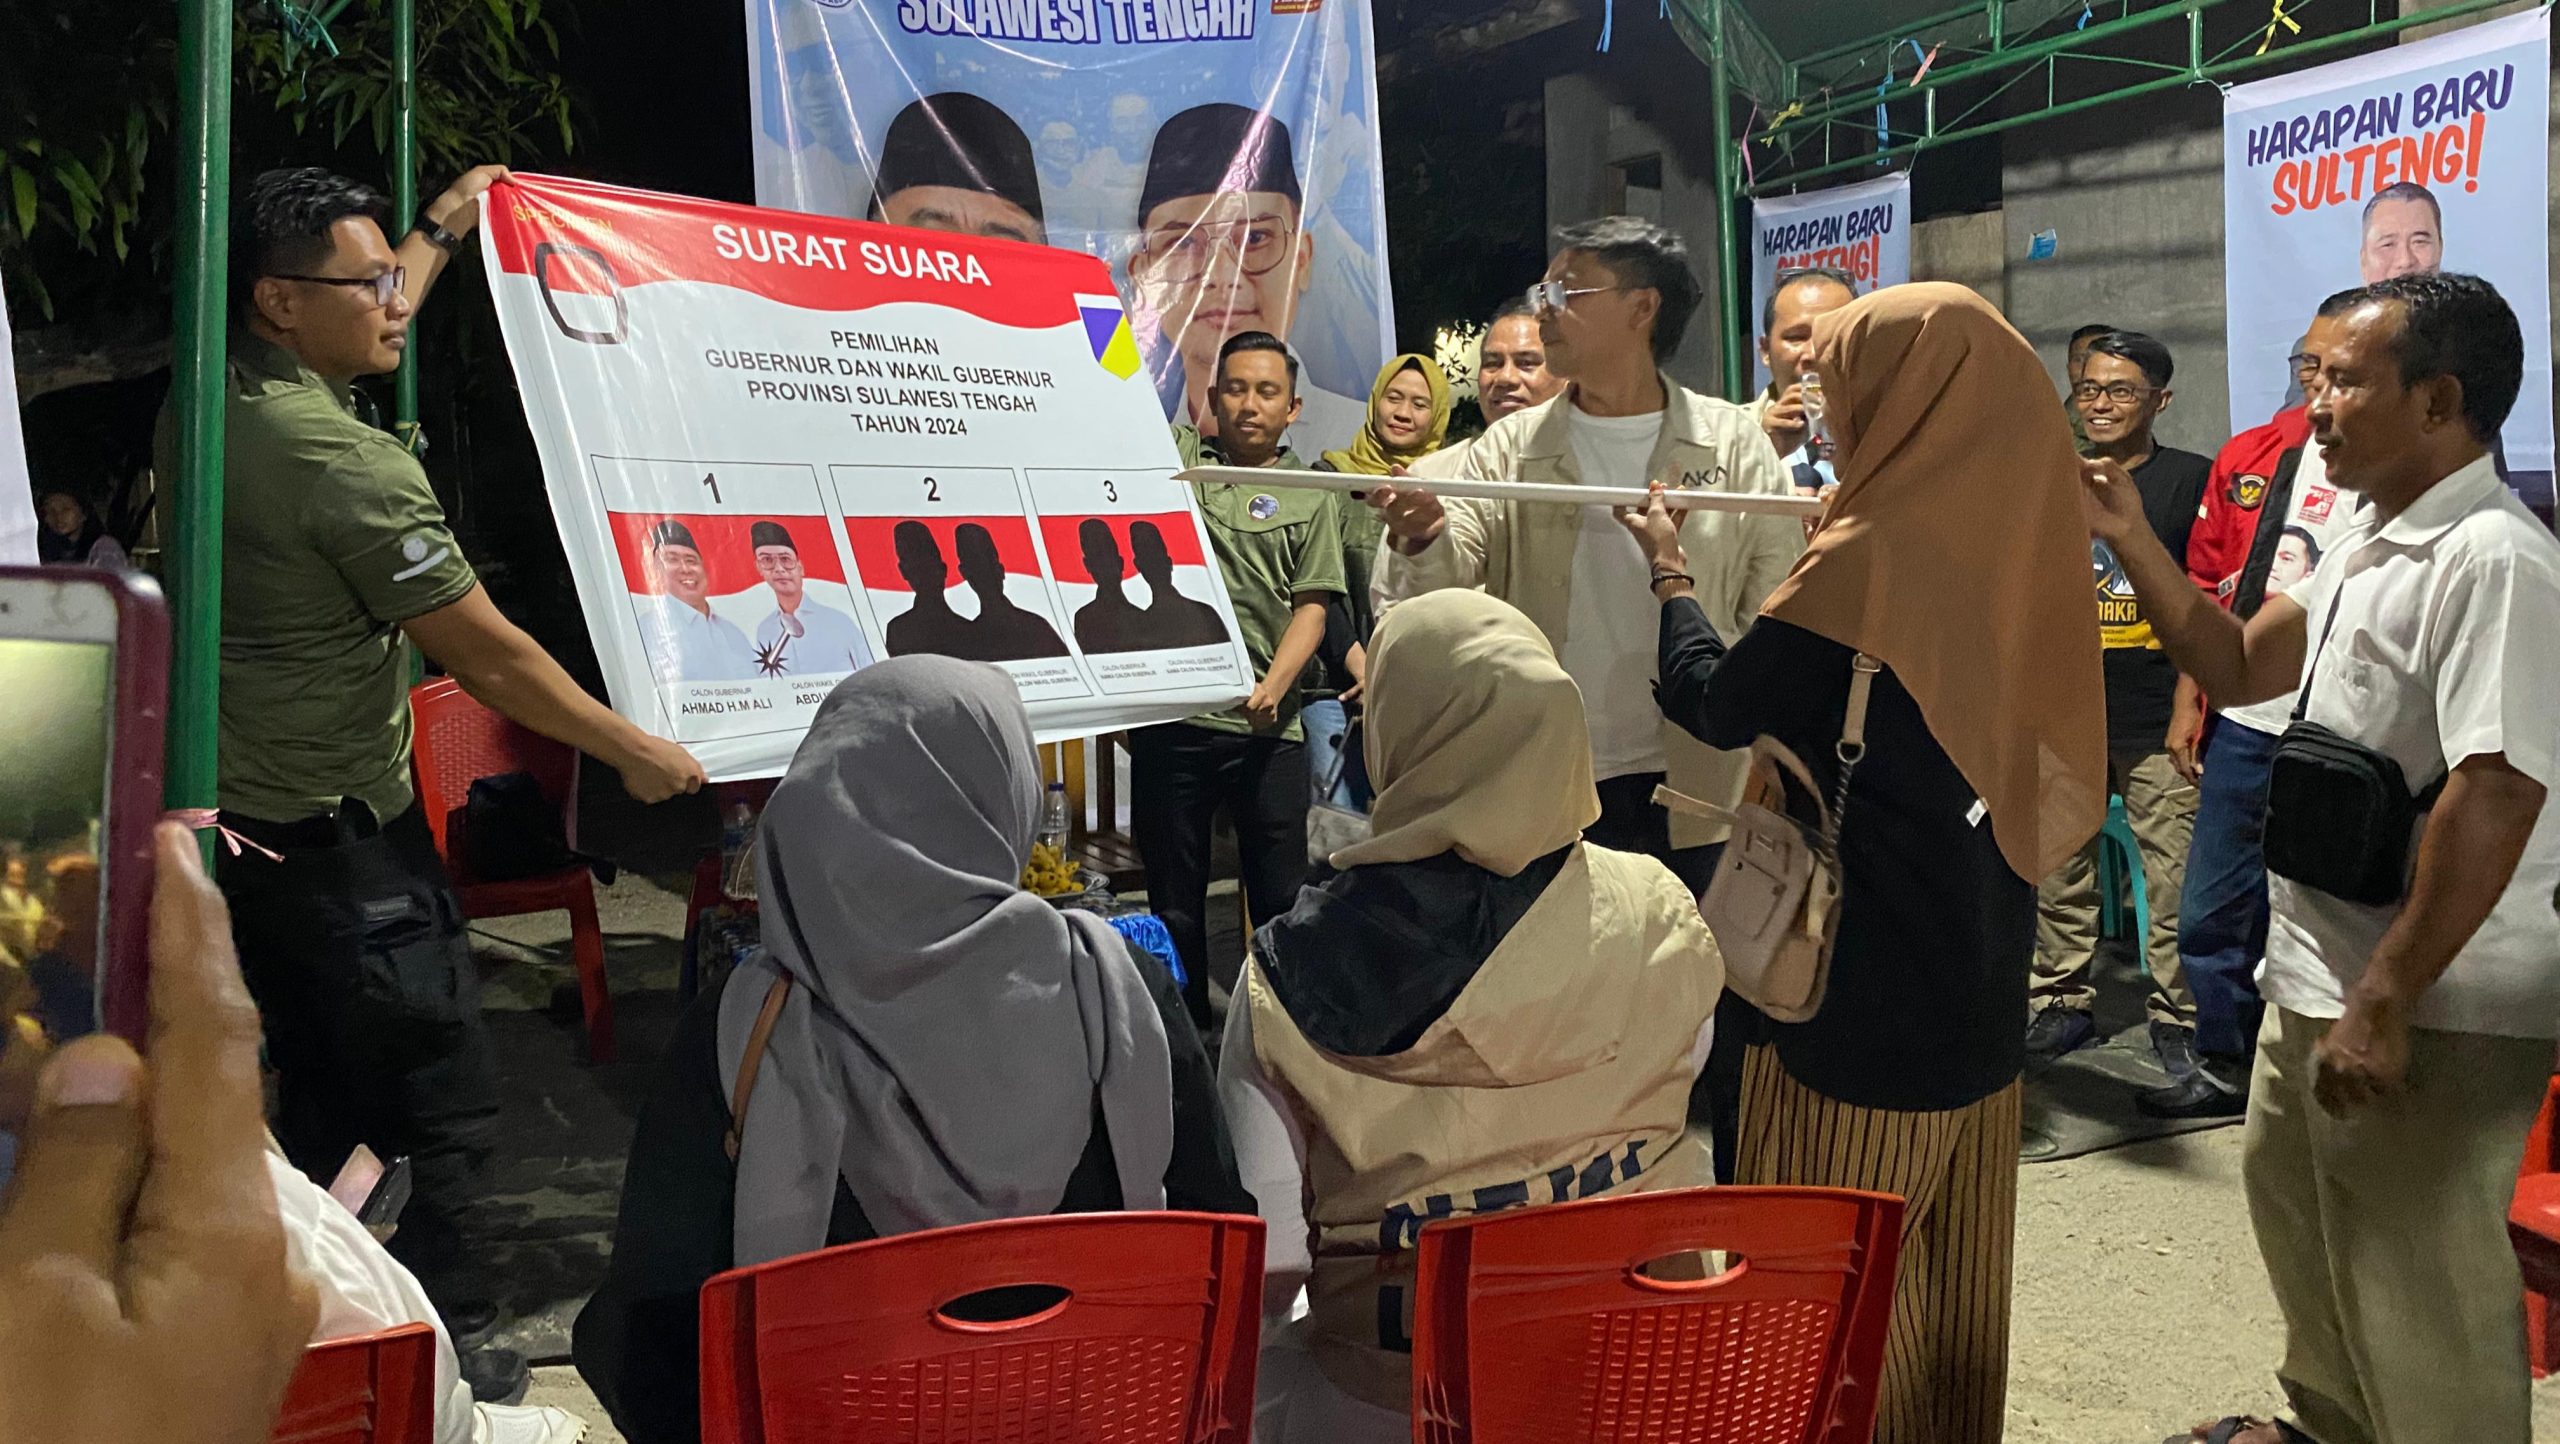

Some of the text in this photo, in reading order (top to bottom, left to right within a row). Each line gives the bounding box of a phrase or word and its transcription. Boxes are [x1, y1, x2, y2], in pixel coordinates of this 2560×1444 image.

[898, 0, 1255, 44] SULAWESI TENGAH
[2248, 63, 2515, 167] HARAPAN BARU
[2271, 111, 2486, 216] SULTENG!
[1763, 203, 1893, 257] HARAPAN BARU
[712, 224, 992, 287] SURAT SUARA
[830, 330, 940, 356] PEMILIHAN
[705, 348, 1055, 388] GUBERNUR DAN WAKIL GUBERNUR
[746, 380, 1037, 413] PROVINSI SULAWESI TENGAH
[851, 414, 968, 436] TAHUN 2024
[702, 472, 723, 504] 1
[923, 476, 942, 502] 2
[1103, 479, 1118, 503] 3
[691, 687, 752, 697] CALON GUBERNUR
[791, 681, 814, 690] CALON
[682, 698, 773, 715] AHMAD H.M ALI
